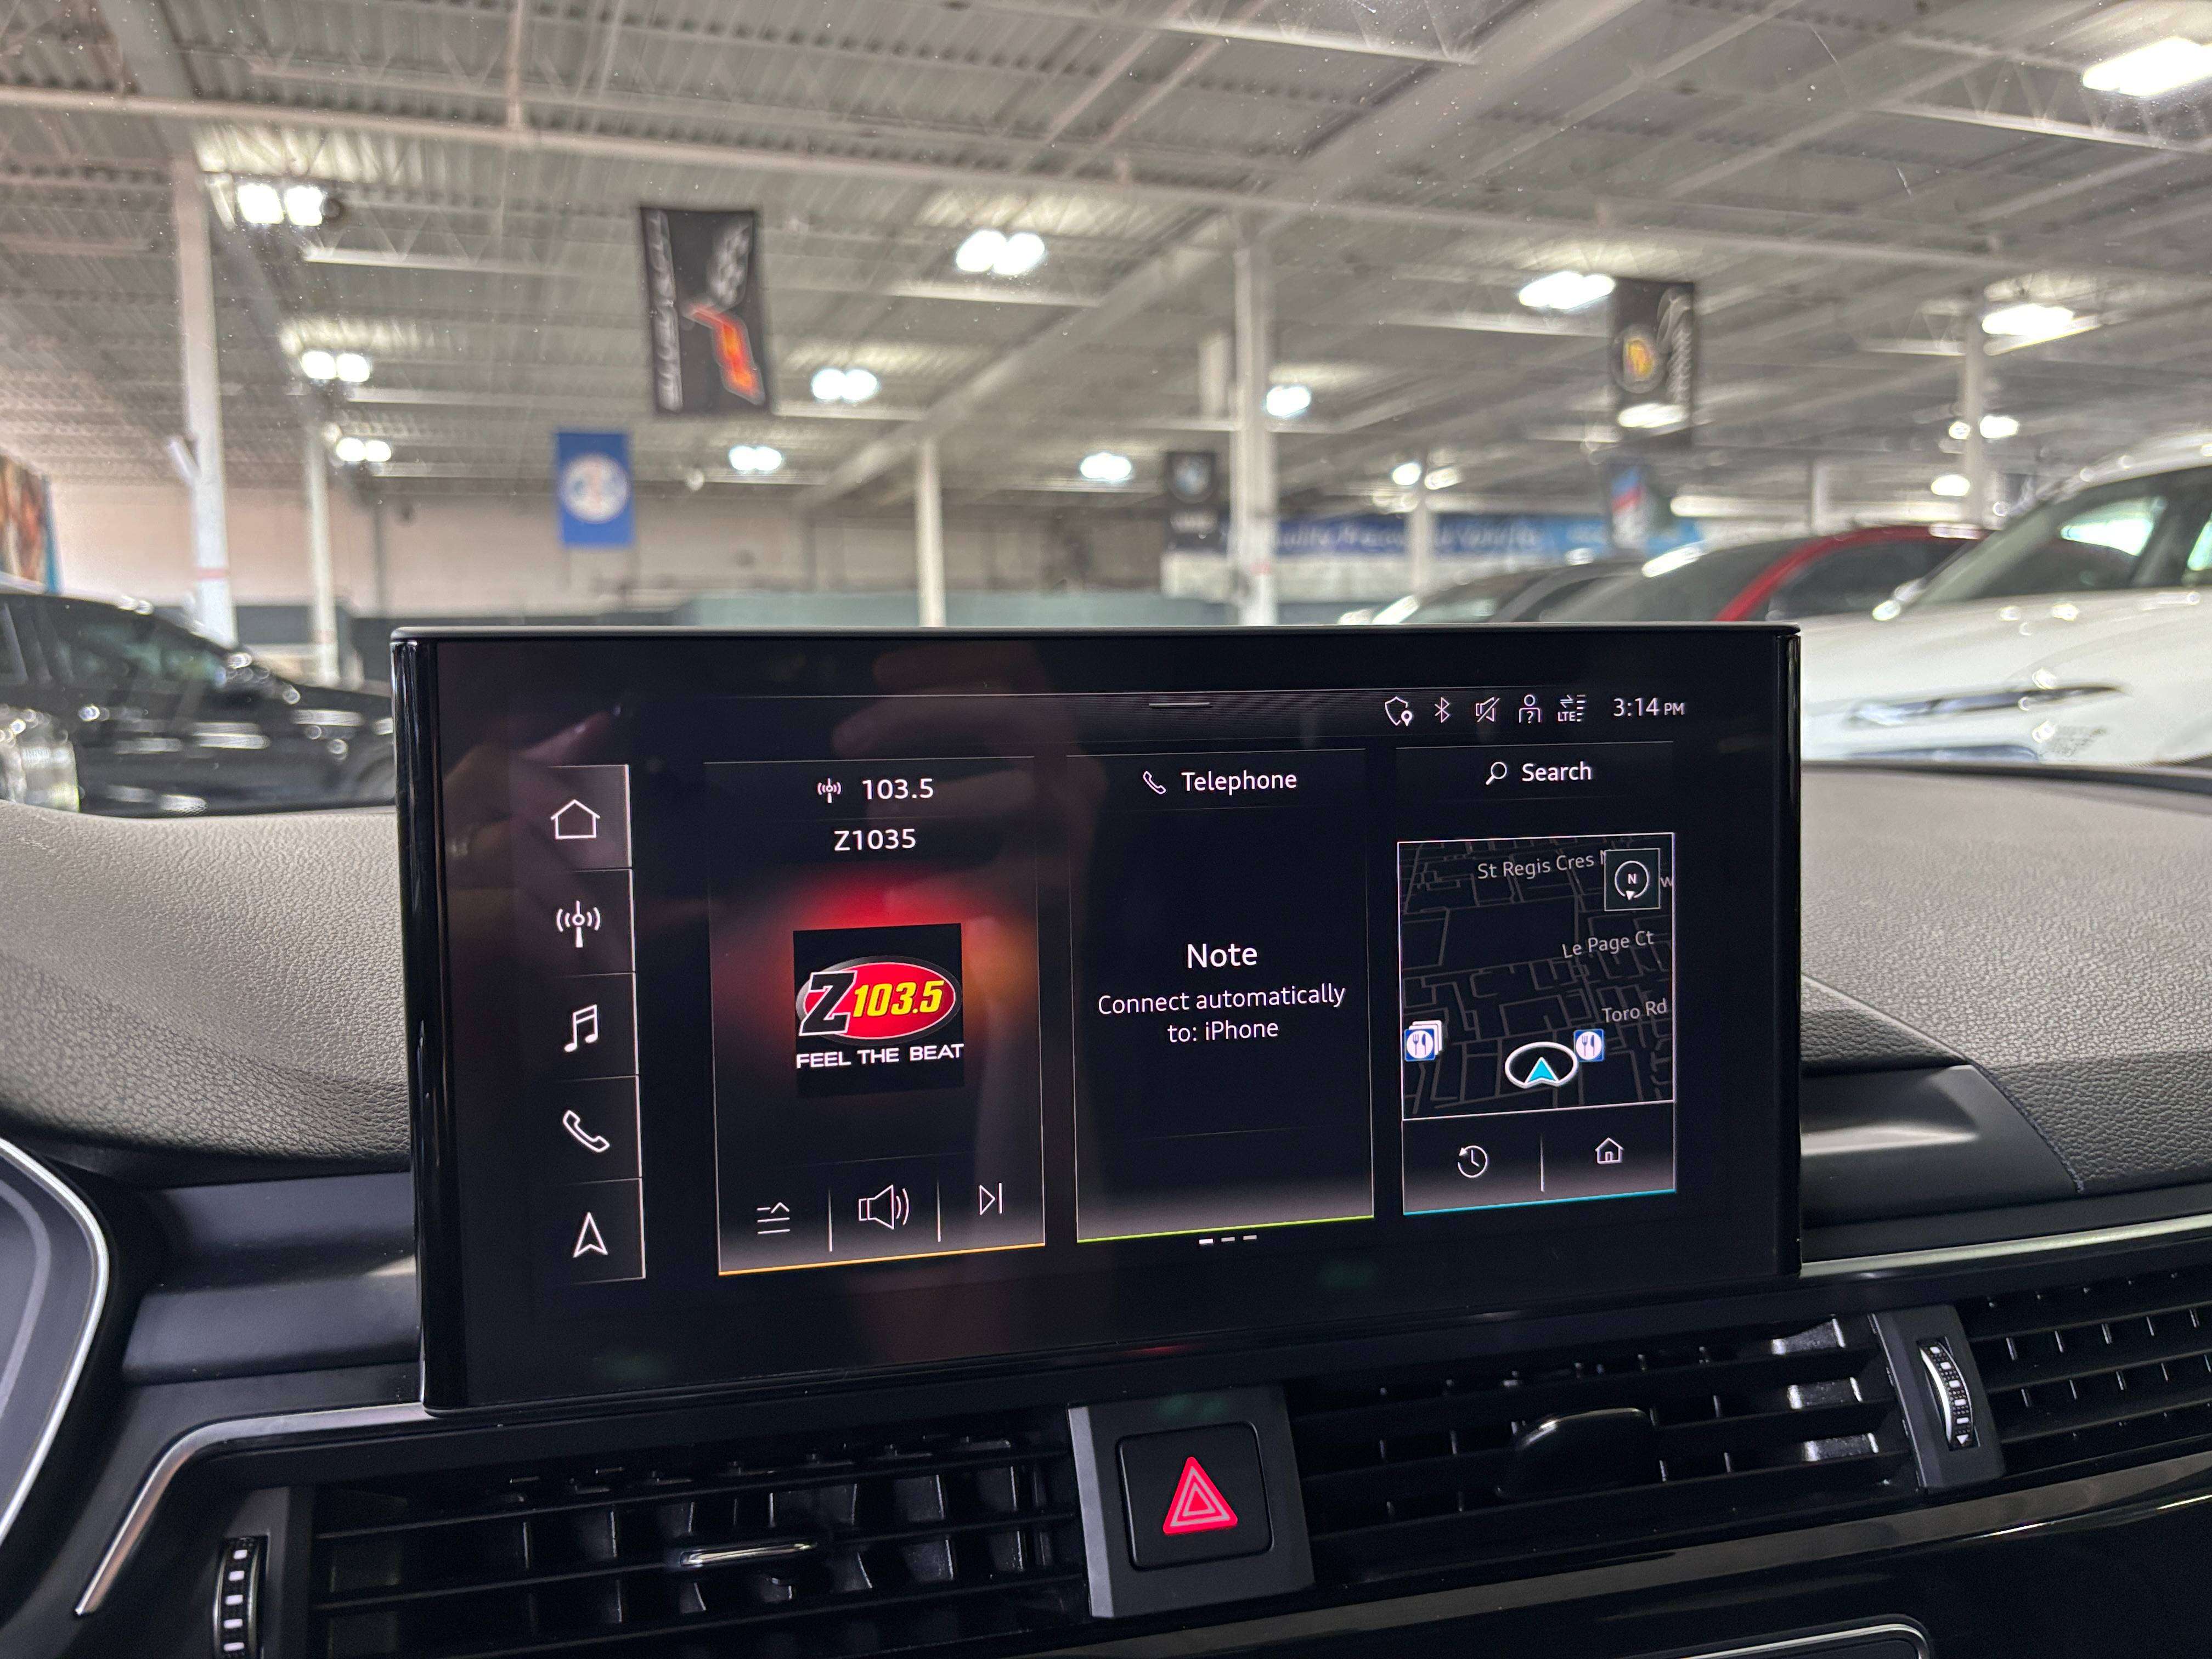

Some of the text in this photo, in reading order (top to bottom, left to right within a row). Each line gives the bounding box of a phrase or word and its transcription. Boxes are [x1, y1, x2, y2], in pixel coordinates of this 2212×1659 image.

[1558, 712, 1575, 721] LTE
[1614, 698, 1684, 716] 3:14 PM
[1181, 770, 1296, 795] Telephone
[1522, 761, 1592, 781] Search
[862, 778, 933, 799] 103.5
[834, 829, 916, 851] Z1035
[1479, 864, 1497, 879] St
[1503, 859, 1550, 879] Regis
[1557, 855, 1594, 870] Cres
[1628, 873, 1637, 884] N
[1188, 944, 1257, 968] Note
[1562, 931, 1654, 958] Le Page Ct
[1099, 983, 1345, 1014] Connect automatically
[1602, 998, 1667, 1023] Toro Rd
[1167, 1020, 1278, 1042] to: iPhone
[797, 1043, 964, 1068] FEEL THE BEAT
